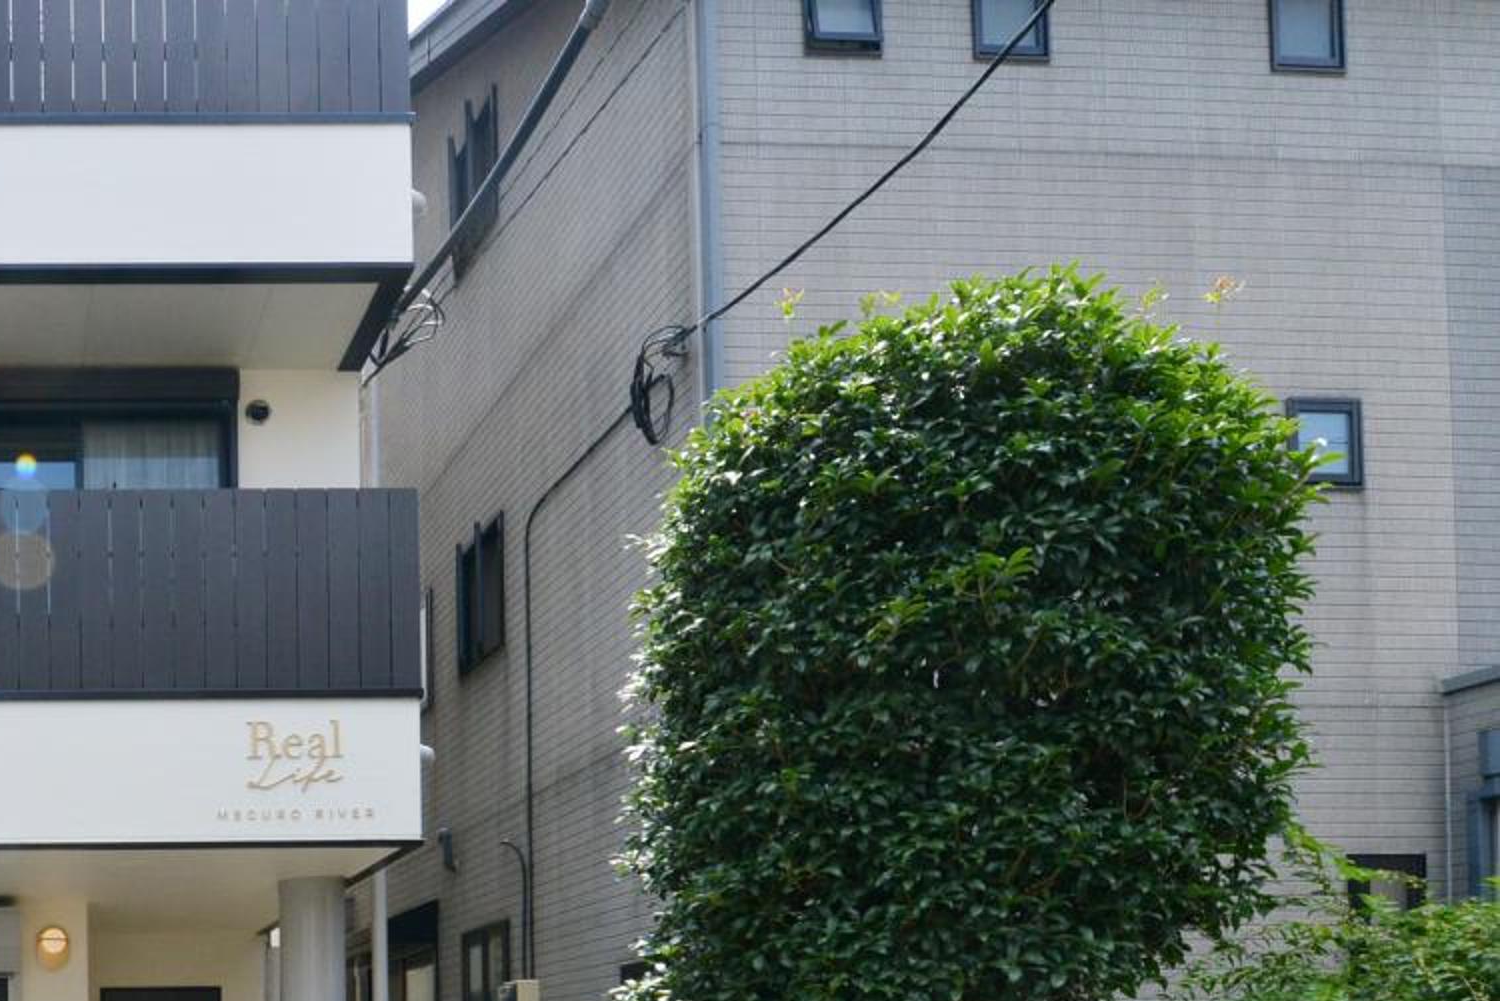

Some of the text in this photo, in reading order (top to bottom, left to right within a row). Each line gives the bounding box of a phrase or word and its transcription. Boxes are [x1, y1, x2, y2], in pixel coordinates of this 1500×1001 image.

[246, 720, 344, 759] Real
[246, 760, 343, 793] Life
[315, 807, 375, 820] RIVER
